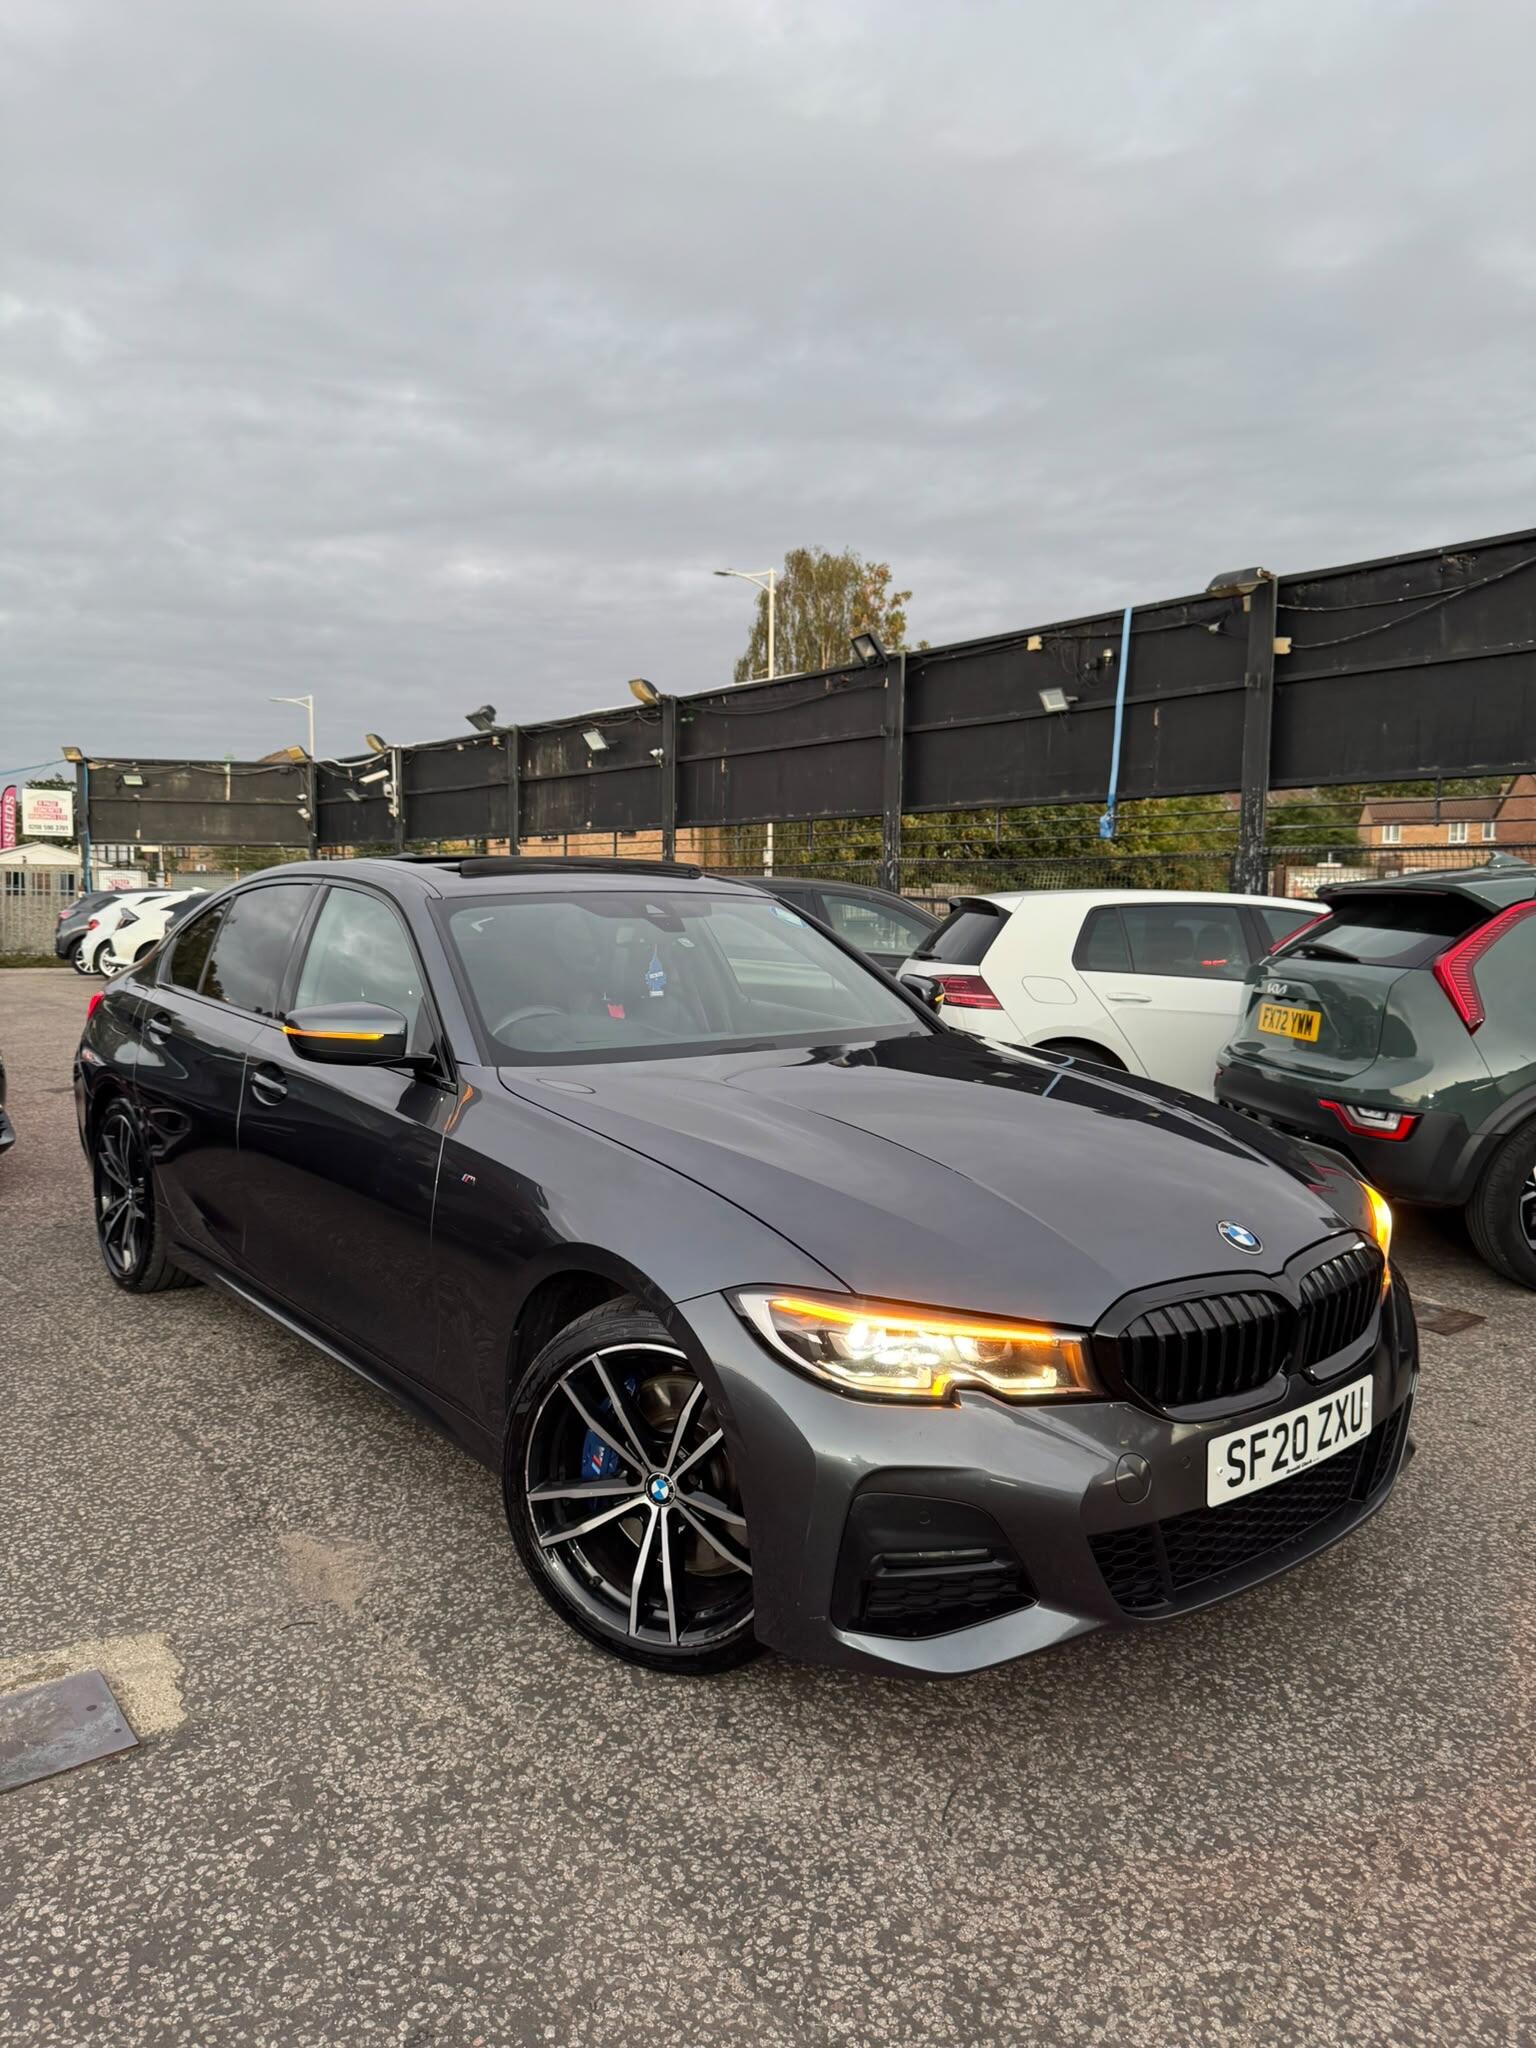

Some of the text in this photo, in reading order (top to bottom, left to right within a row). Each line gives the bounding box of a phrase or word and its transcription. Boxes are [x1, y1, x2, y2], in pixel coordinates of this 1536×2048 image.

[1267, 983, 1288, 994] KIA
[1262, 1006, 1289, 1031] FX72
[1227, 1387, 1363, 1487] SF20 ZXU
